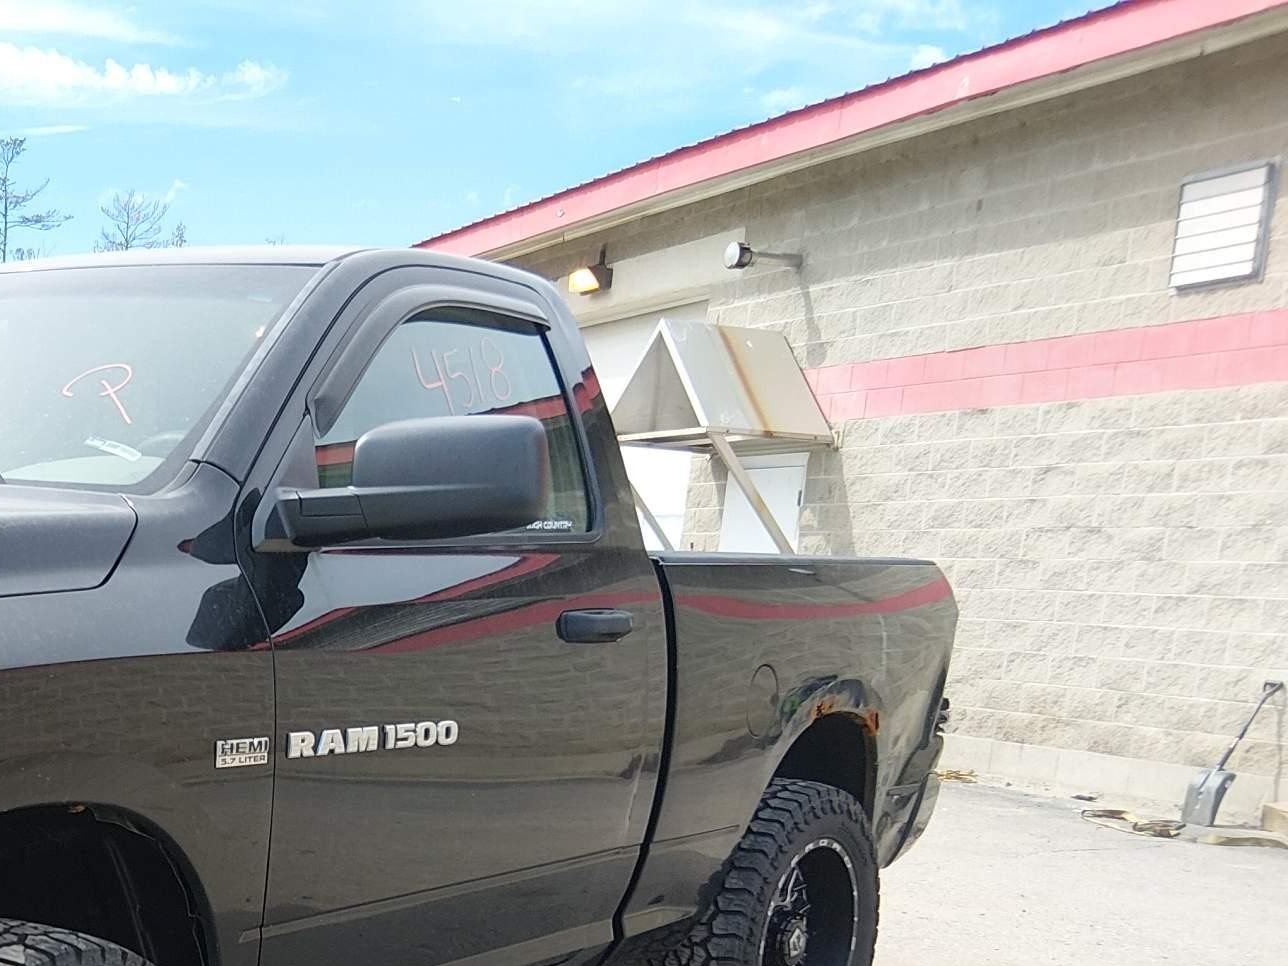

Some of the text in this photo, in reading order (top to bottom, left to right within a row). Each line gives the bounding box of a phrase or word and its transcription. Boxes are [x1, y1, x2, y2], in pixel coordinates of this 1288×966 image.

[410, 336, 512, 416] 4518
[221, 738, 268, 755] HEMI
[288, 720, 459, 759] RAM 1500
[220, 754, 266, 766] 5.7 LITER
